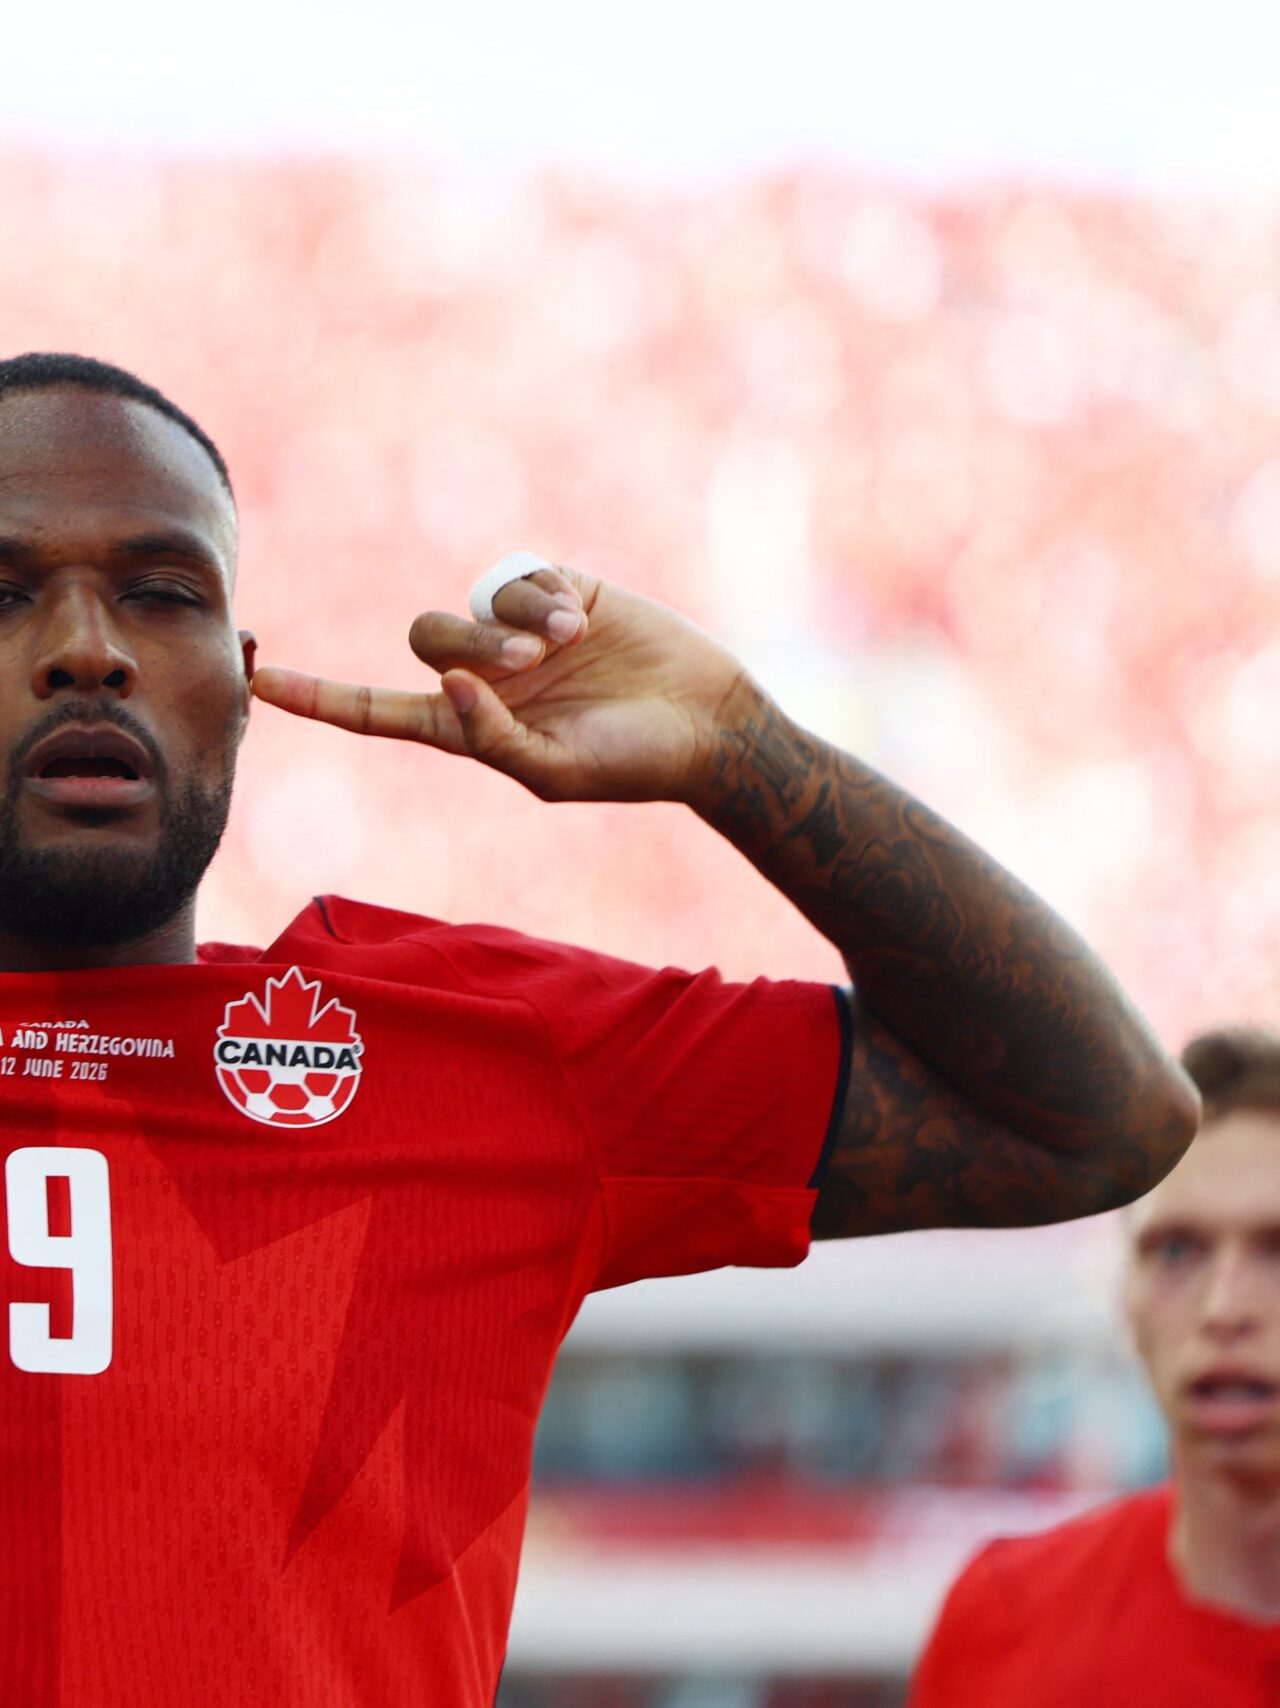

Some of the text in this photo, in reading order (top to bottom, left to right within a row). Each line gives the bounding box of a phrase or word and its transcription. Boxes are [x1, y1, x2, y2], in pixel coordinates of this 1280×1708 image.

[11, 1030, 48, 1050] AND
[55, 1034, 176, 1058] HERZEGOVINA
[218, 1040, 358, 1070] CANADA
[1, 1057, 109, 1081] 12 JUNE 2026
[5, 1147, 114, 1375] 9
